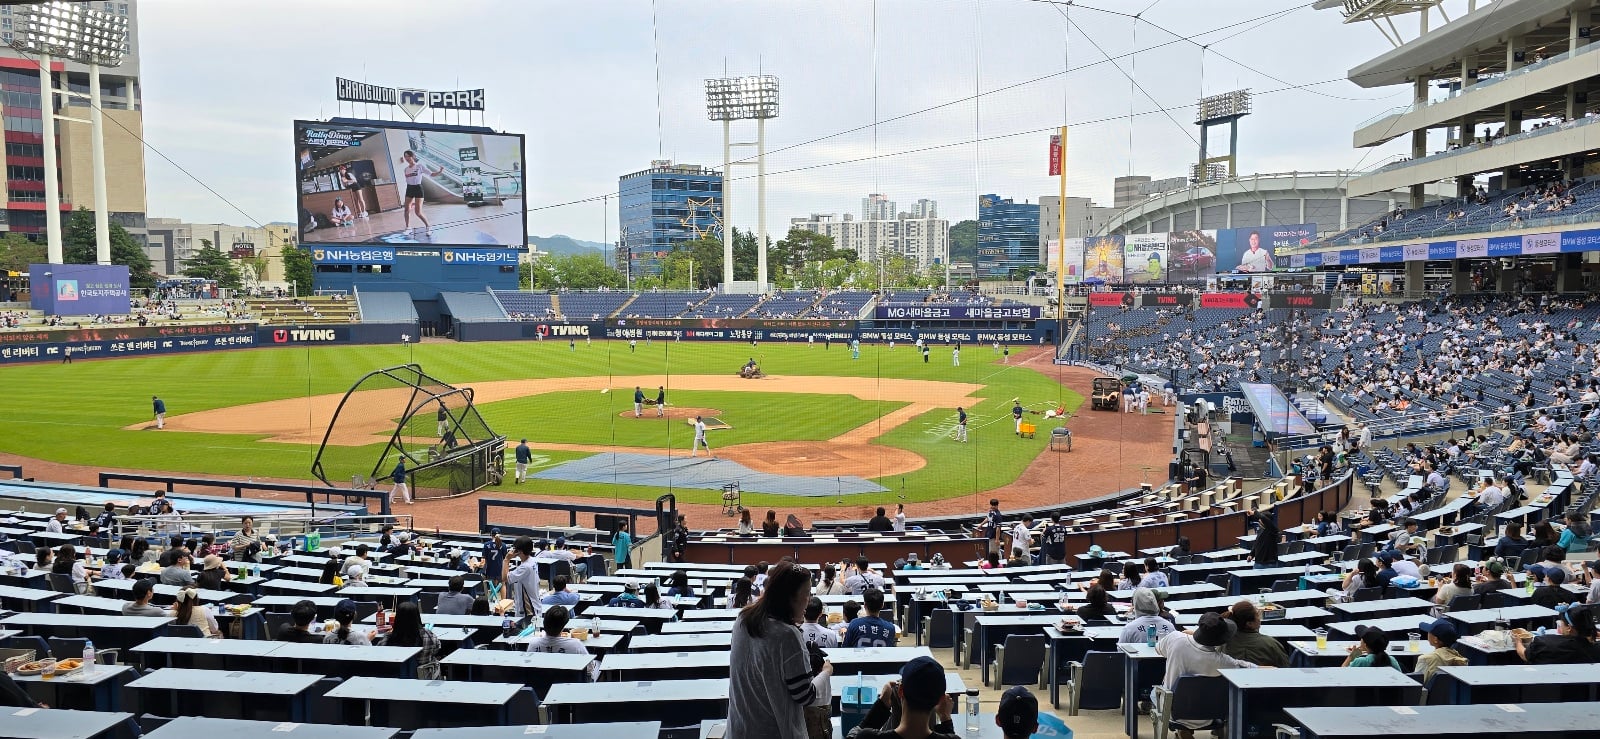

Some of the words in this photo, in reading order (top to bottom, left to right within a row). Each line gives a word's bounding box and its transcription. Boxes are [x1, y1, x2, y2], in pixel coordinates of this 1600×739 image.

[338, 77, 396, 102] CHANGWON
[430, 91, 483, 109] PARK
[80, 289, 127, 297] 한국토지주택공사
[1287, 297, 1313, 305] TVING
[290, 329, 336, 341] TVING
[551, 325, 589, 336] TVING
[862, 332, 880, 340] BMW
[135, 340, 157, 350] 리버티
[12, 346, 39, 358] 리버티
[490, 550, 499, 561] 7
